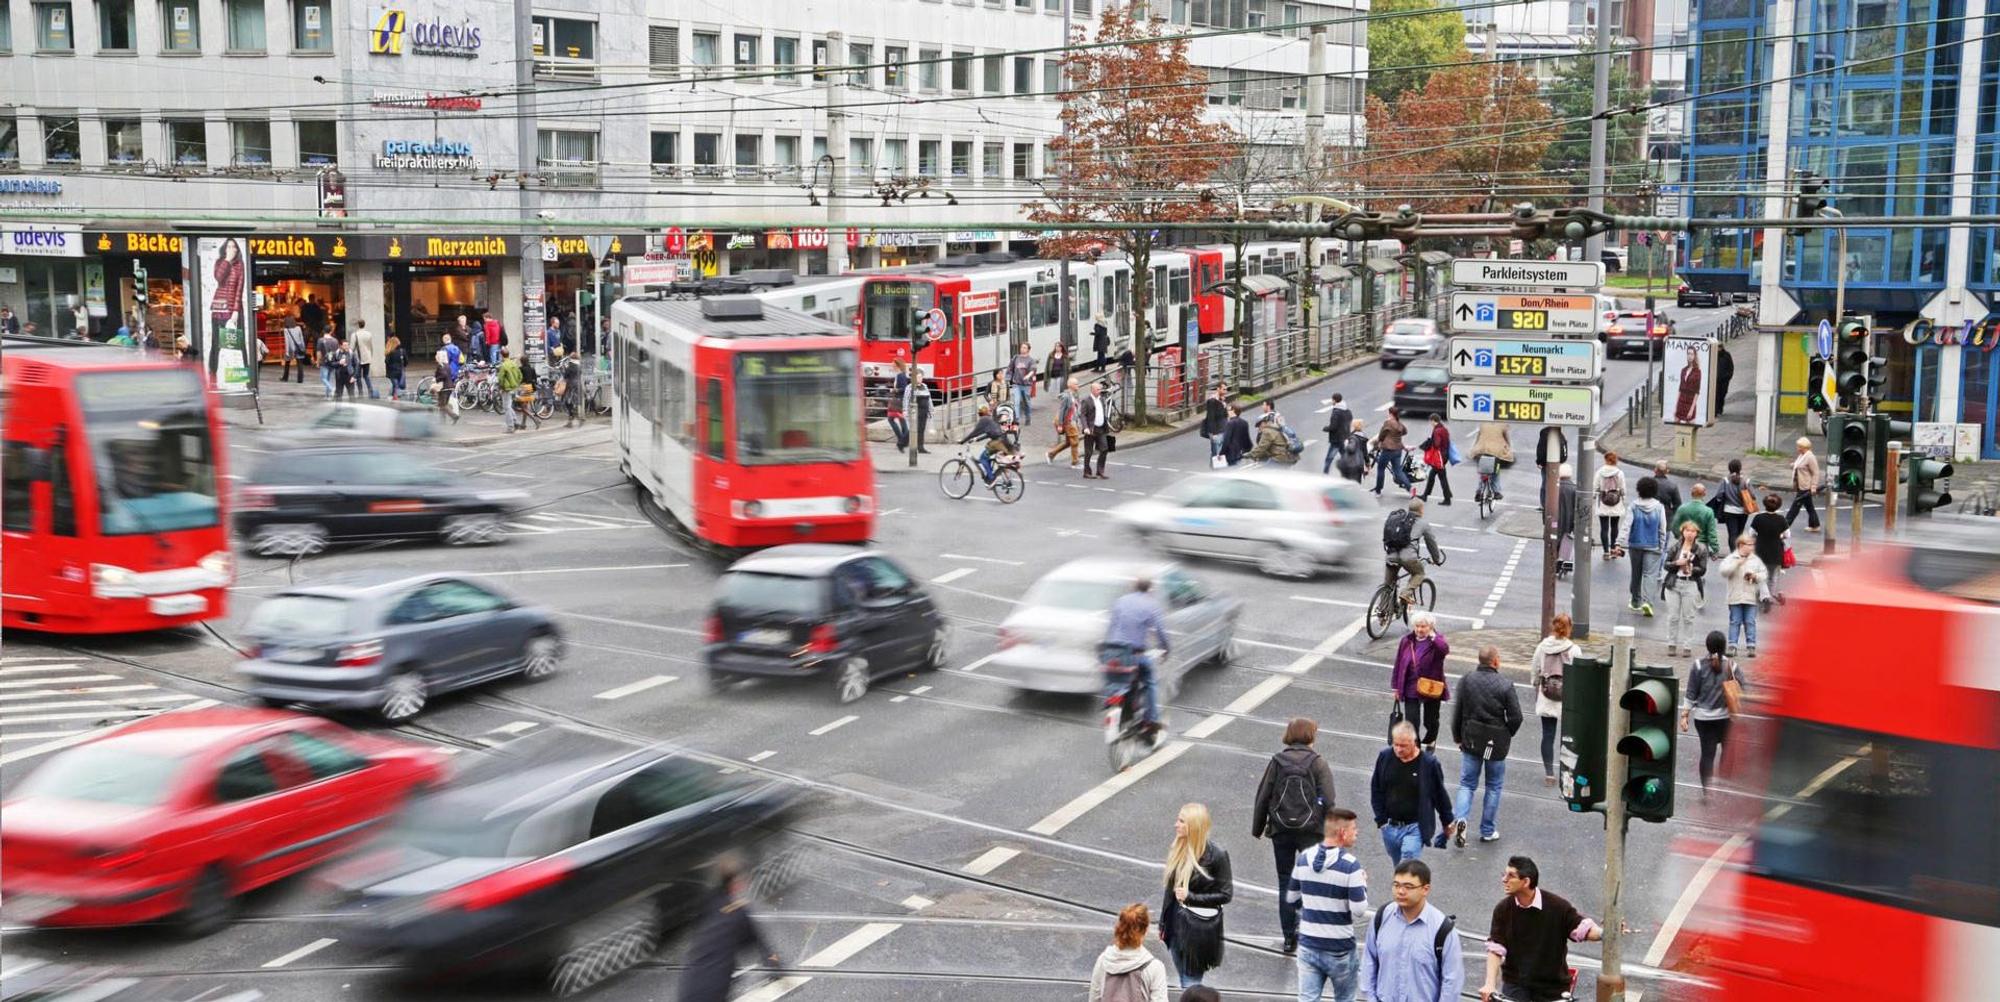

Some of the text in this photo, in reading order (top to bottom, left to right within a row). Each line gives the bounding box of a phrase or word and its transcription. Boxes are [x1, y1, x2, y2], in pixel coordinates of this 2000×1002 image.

[415, 16, 481, 48] adevis
[386, 137, 472, 157] paracelsus
[376, 153, 481, 170] heilpraktikerschule
[0, 178, 61, 193] aracelsus
[14, 226, 65, 246] adevis
[428, 236, 506, 256] Merzenich
[1046, 268, 1055, 278] 4
[1482, 266, 1568, 282] Parkleitsystem
[1520, 298, 1569, 309] Dom/Rhein
[1512, 311, 1545, 329] 920
[1522, 344, 1564, 355] Neumarkt
[1666, 341, 1709, 352] MANGO
[1500, 357, 1543, 374] 1578
[1529, 389, 1554, 400] Ringe
[1498, 402, 1541, 420] 1480
